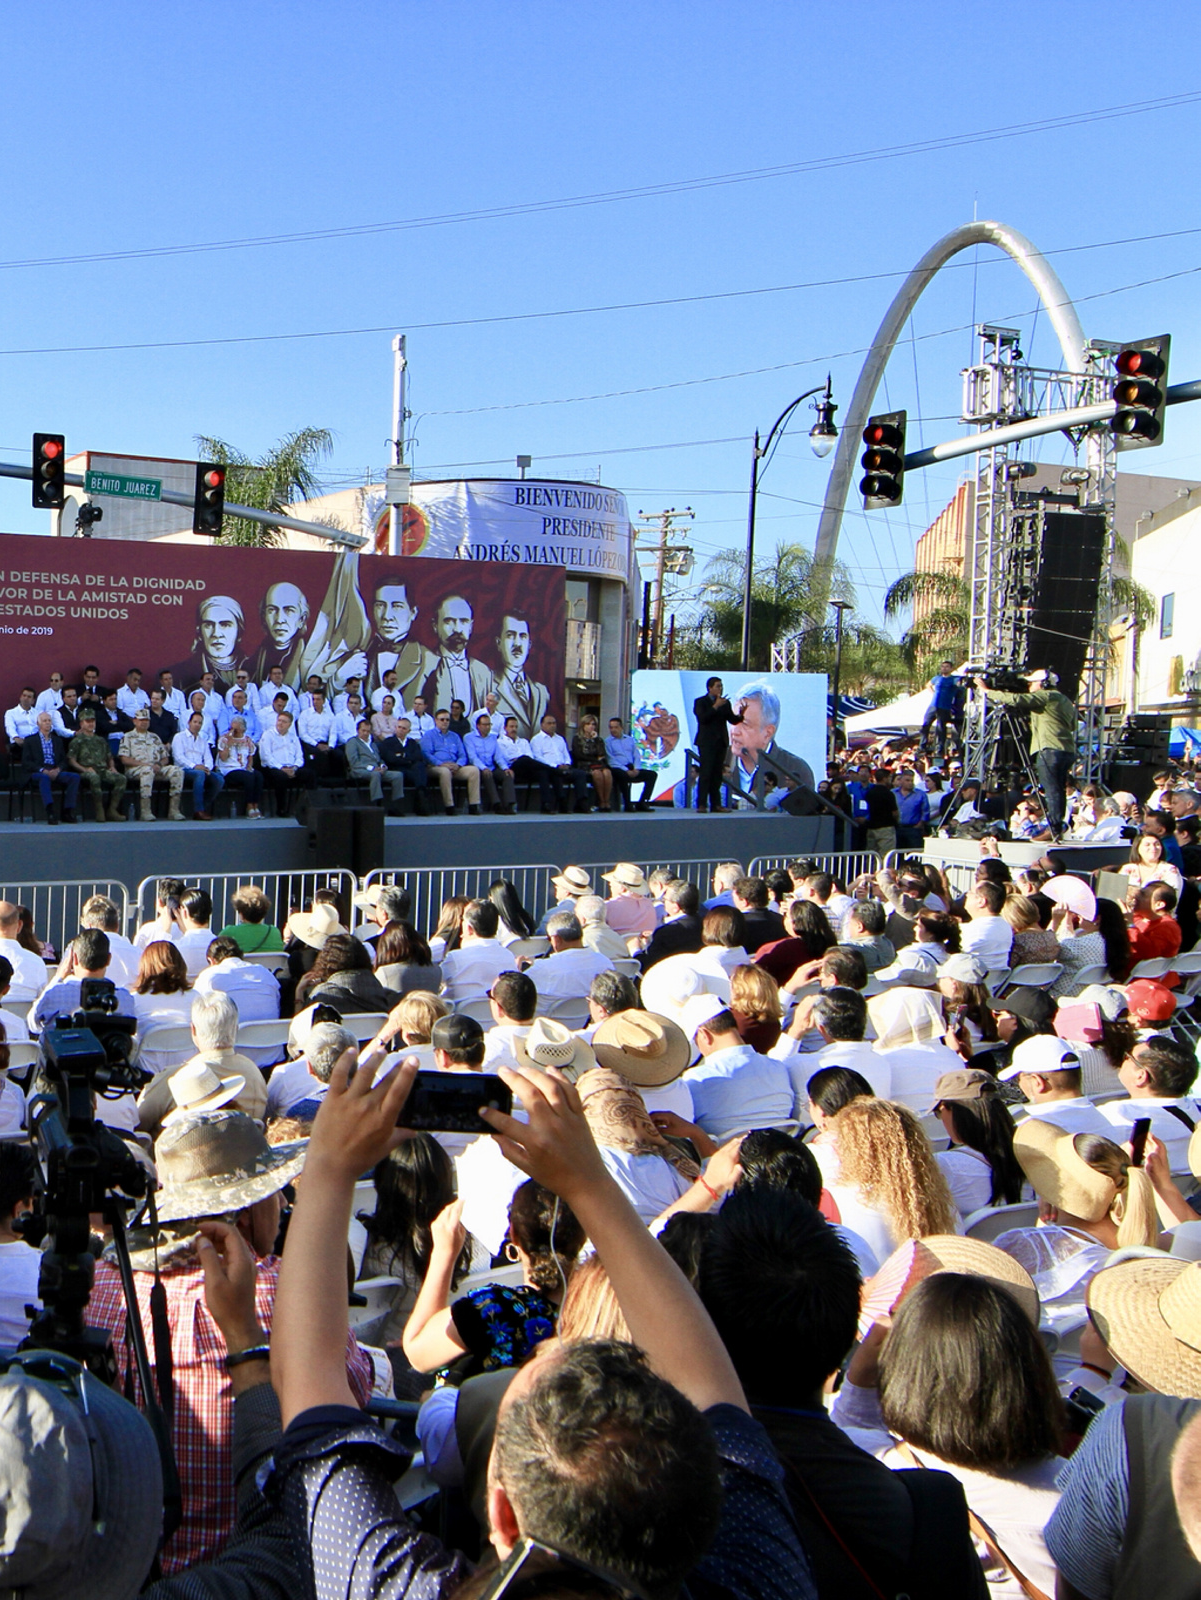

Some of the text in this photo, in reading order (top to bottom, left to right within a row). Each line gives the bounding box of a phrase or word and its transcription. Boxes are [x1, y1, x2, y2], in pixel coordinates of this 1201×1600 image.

[91, 477, 157, 496] BENITO JUAREZ
[515, 487, 601, 511] BIENVENIDO
[542, 517, 615, 542] PRESIDENTE
[453, 539, 520, 562] ANDRÉS
[523, 545, 585, 566] MANUEL
[588, 546, 617, 570] LÓPEZ
[10, 571, 80, 585] DEFENSA
[85, 574, 105, 586] DE
[110, 576, 129, 588] LA
[133, 577, 206, 591] DIGNIDAD
[32, 588, 53, 600] DE
[57, 590, 77, 601] LA
[81, 591, 147, 604] AMISTAD
[151, 594, 183, 606] CON
[70, 606, 129, 620] UNIDOS
[16, 626, 29, 635] de
[31, 626, 54, 636] 2019
